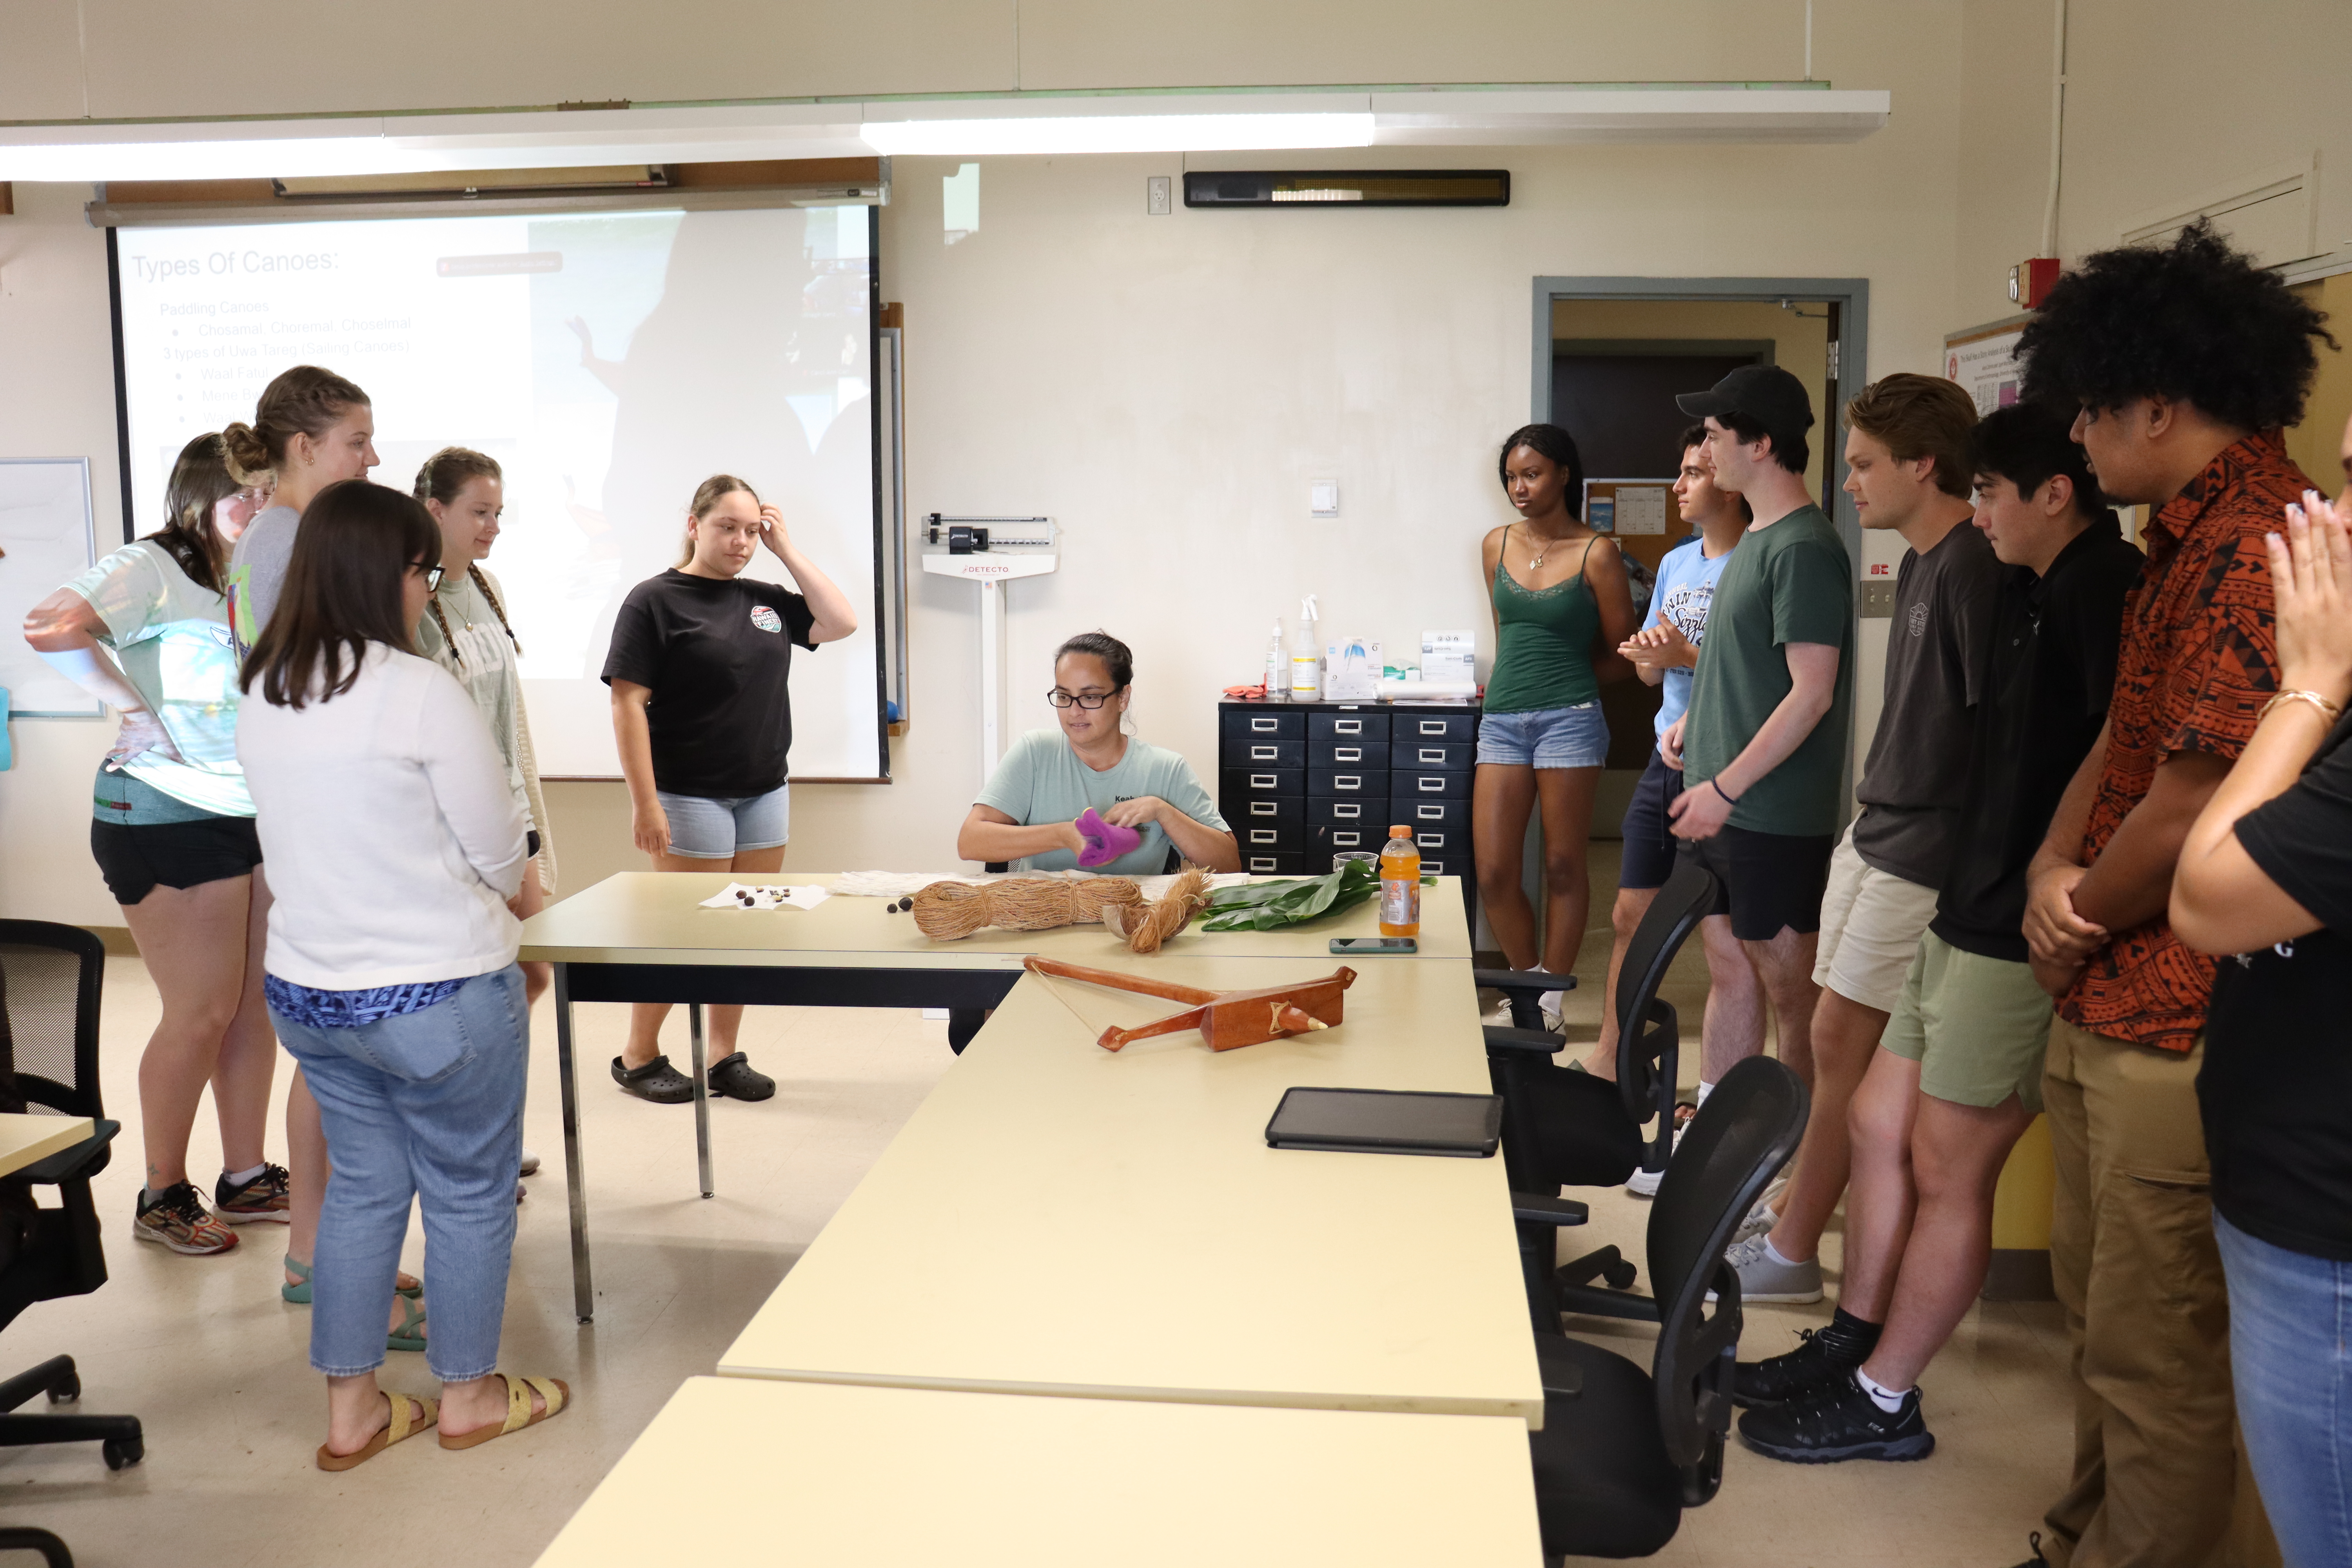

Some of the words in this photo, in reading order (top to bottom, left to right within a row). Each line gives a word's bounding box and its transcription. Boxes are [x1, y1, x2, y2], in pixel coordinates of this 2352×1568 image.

[132, 255, 200, 283] Types
[209, 251, 235, 275] Of
[243, 250, 338, 274] Canoes:
[160, 302, 216, 316] Paddling
[220, 300, 269, 313] Canoes
[199, 322, 266, 336] Chosamal,
[341, 317, 411, 330] Choselmal
[163, 347, 171, 360] 3
[174, 346, 209, 362] types
[213, 345, 225, 358] of
[229, 345, 257, 357] Uwa
[261, 343, 297, 358] Tareg
[302, 341, 349, 356] (Sailing
[354, 339, 409, 355] Canoes)
[201, 367, 232, 380] Waal
[238, 367, 268, 378] Fatul
[202, 390, 238, 402] Mene
[243, 388, 263, 400] Bw
[1666, 582, 1688, 599] ANNUAL
[757, 618, 778, 626] FINEST
